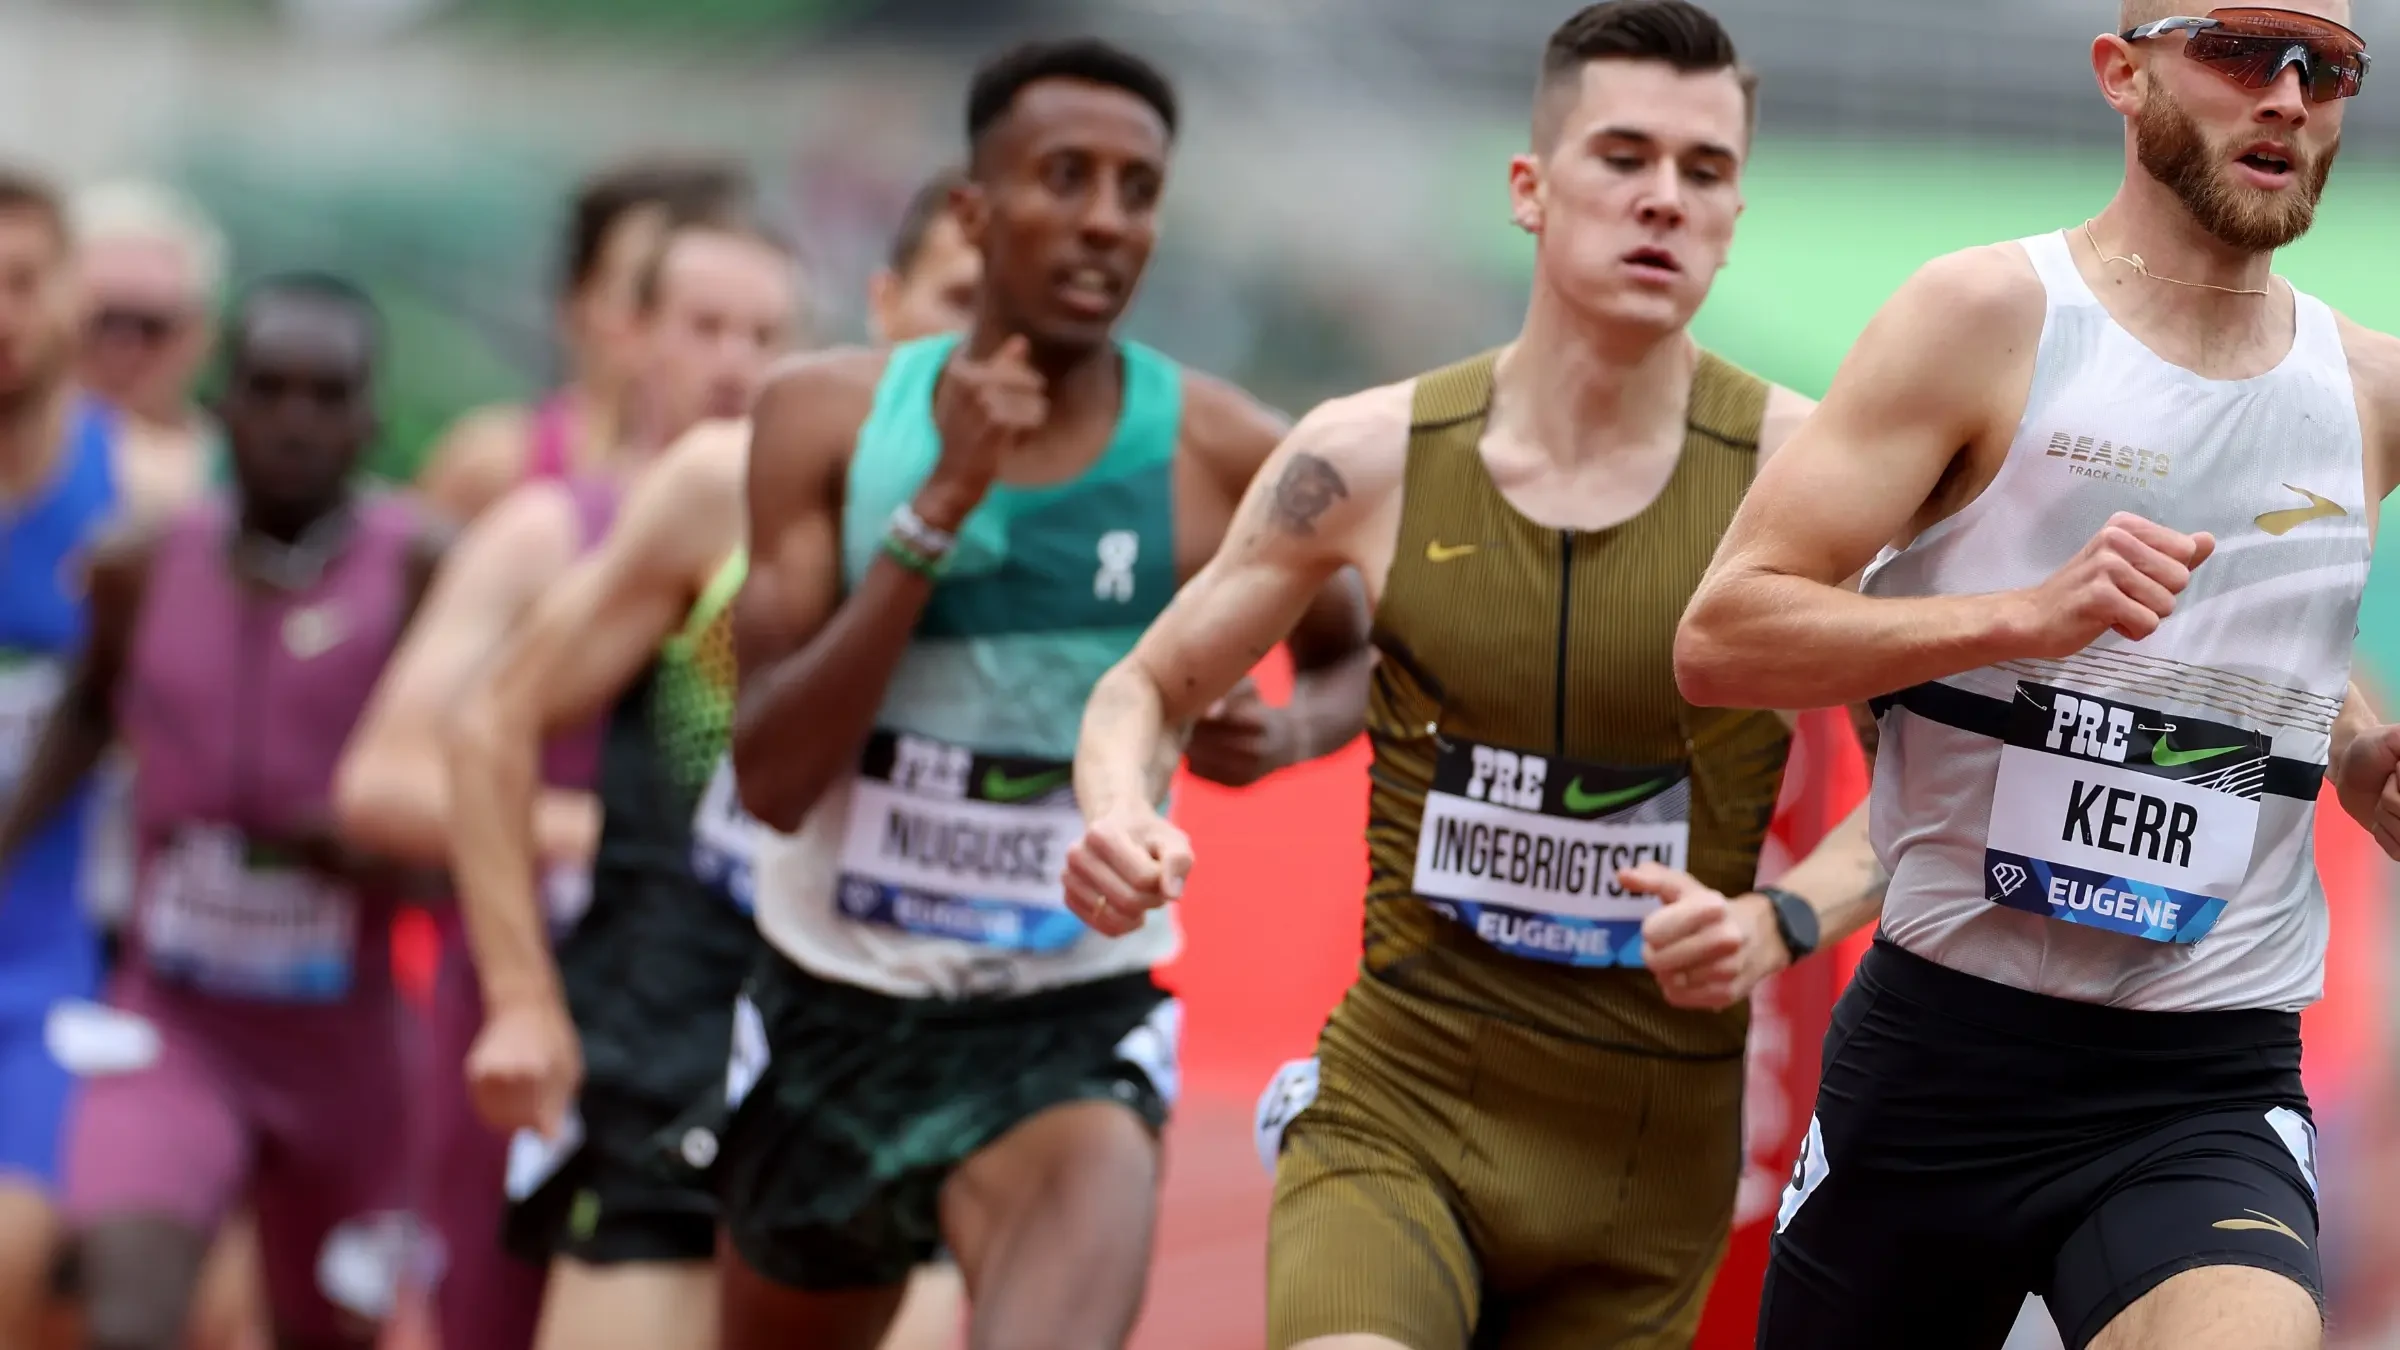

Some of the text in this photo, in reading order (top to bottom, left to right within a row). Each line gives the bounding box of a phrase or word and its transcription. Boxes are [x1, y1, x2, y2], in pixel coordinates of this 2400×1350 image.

[2068, 464, 2147, 488] TRACK CLUB
[2045, 693, 2135, 763] PRE
[1466, 745, 1547, 811] PRE
[2061, 780, 2199, 868] KERR
[2047, 876, 2182, 930] EUGENE
[1477, 912, 1612, 956] EUGENE
